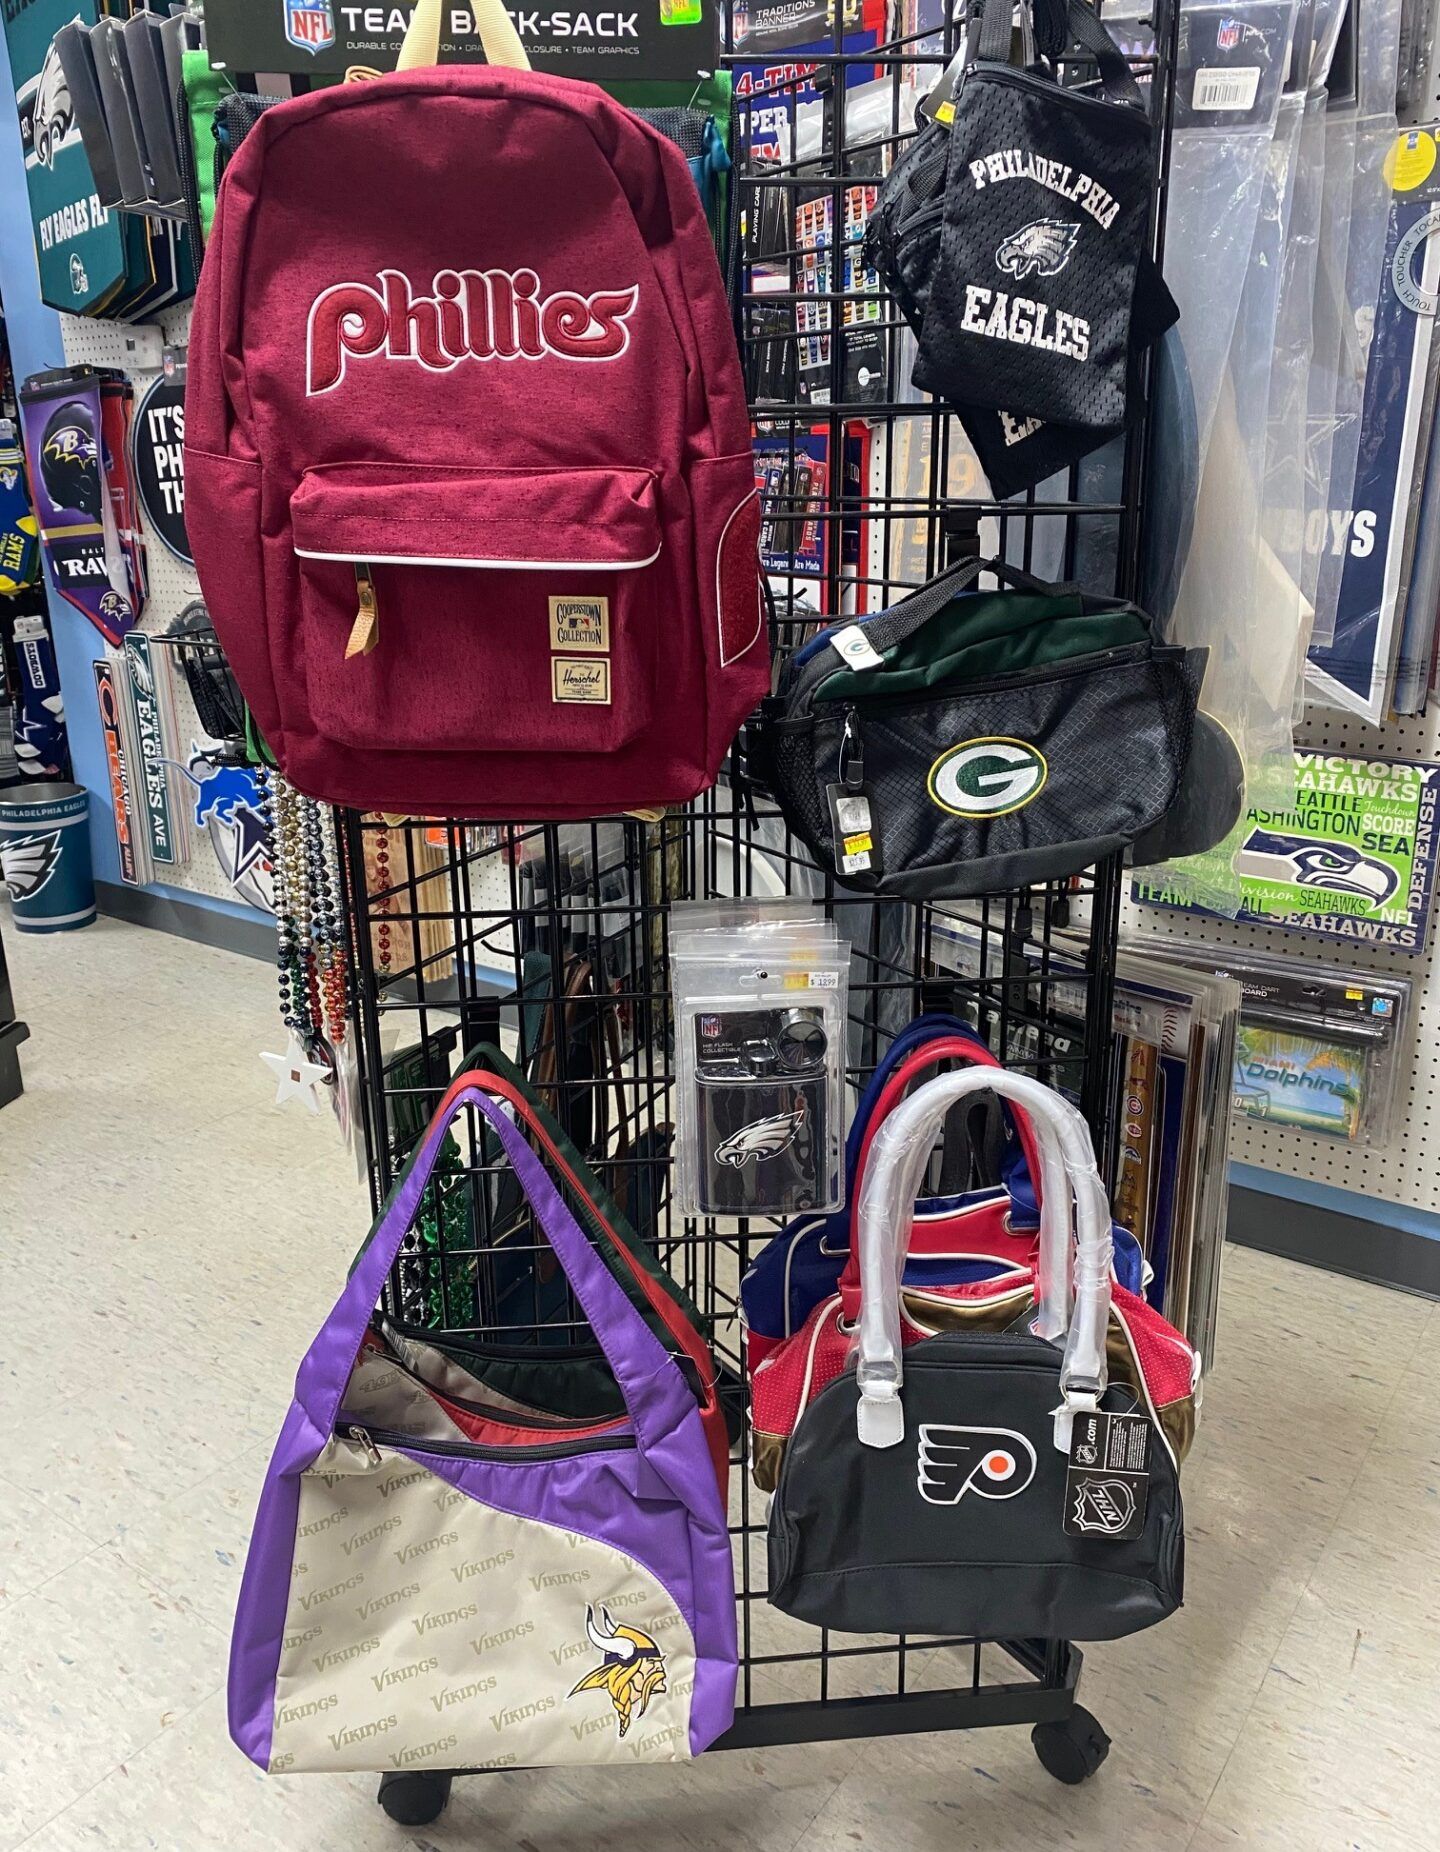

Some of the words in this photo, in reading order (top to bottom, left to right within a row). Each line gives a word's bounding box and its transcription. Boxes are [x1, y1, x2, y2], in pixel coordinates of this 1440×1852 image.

[340, 7, 410, 33] TEA
[450, 10, 639, 37] BK-SACK
[755, 12, 797, 29] BANNER
[756, 0, 816, 19] TRADITIONS
[292, 11, 333, 43] NFL
[346, 42, 387, 50] DURABLE
[572, 46, 595, 54] TEAM
[597, 46, 640, 55] GRAPHICS
[968, 149, 1121, 230] PHILADELPHIA
[53, 198, 90, 243] EAGLES
[752, 209, 761, 243] PLAYING
[1396, 240, 1413, 287] TOUCHER
[1402, 290, 1432, 312] TOUCH
[960, 285, 1090, 361] EAGLES
[147, 405, 185, 443] IT'S
[3, 533, 26, 571] RAMS
[61, 556, 108, 577] RAV
[794, 558, 805, 570] Are
[805, 559, 820, 571] Made
[556, 603, 602, 627] COOPERSTOWN
[557, 626, 602, 645] COLLECTION
[25, 643, 45, 688] COWBOYS
[563, 668, 601, 686] Herschel
[118, 749, 132, 815] CHICAGO
[137, 699, 163, 809] EAGLES
[152, 814, 167, 847] AVE
[1293, 752, 1439, 784] VICTORY
[1, 806, 62, 817] PHILADELPHIA
[63, 799, 86, 812] EAGLES
[105, 729, 131, 845] BEARS
[124, 846, 134, 877] ALLEY
[1296, 789, 1363, 814] EATTLE
[1363, 800, 1416, 818] Touchdown
[1246, 807, 1361, 837] ASHINGTON
[1361, 813, 1416, 837] SCORE
[1360, 831, 1410, 857] SEA
[1407, 786, 1438, 911] DEFENSE
[1300, 889, 1367, 916] SEAHAWKS
[1380, 907, 1419, 928] NFL
[1246, 1062, 1350, 1095] Dolphins
[1251, 1055, 1296, 1071] MIAMI
[1088, 1418, 1097, 1445] .com
[376, 1469, 434, 1498] VIKING
[298, 1506, 350, 1538] IKINGS
[1092, 1489, 1121, 1522] NHL
[340, 1514, 402, 1556] VIKINGS
[393, 1531, 459, 1565] VIKINGS
[450, 1548, 515, 1583] VIKINGS
[529, 1569, 592, 1593] VIKINGS
[298, 1572, 365, 1612] VIKINGS
[355, 1581, 421, 1621] VIKINGS
[412, 1603, 478, 1636] VIKINGS
[311, 1636, 381, 1673] VIKINGS
[470, 1621, 535, 1656] VIKINGS
[370, 1656, 439, 1692] VIKINGS
[429, 1675, 498, 1712] VIKINGS
[489, 1695, 556, 1733] VIKINGS
[328, 1714, 398, 1751] VIKINGS
[628, 1724, 685, 1758] VIKINGS
[388, 1733, 459, 1768] VIKINGS
